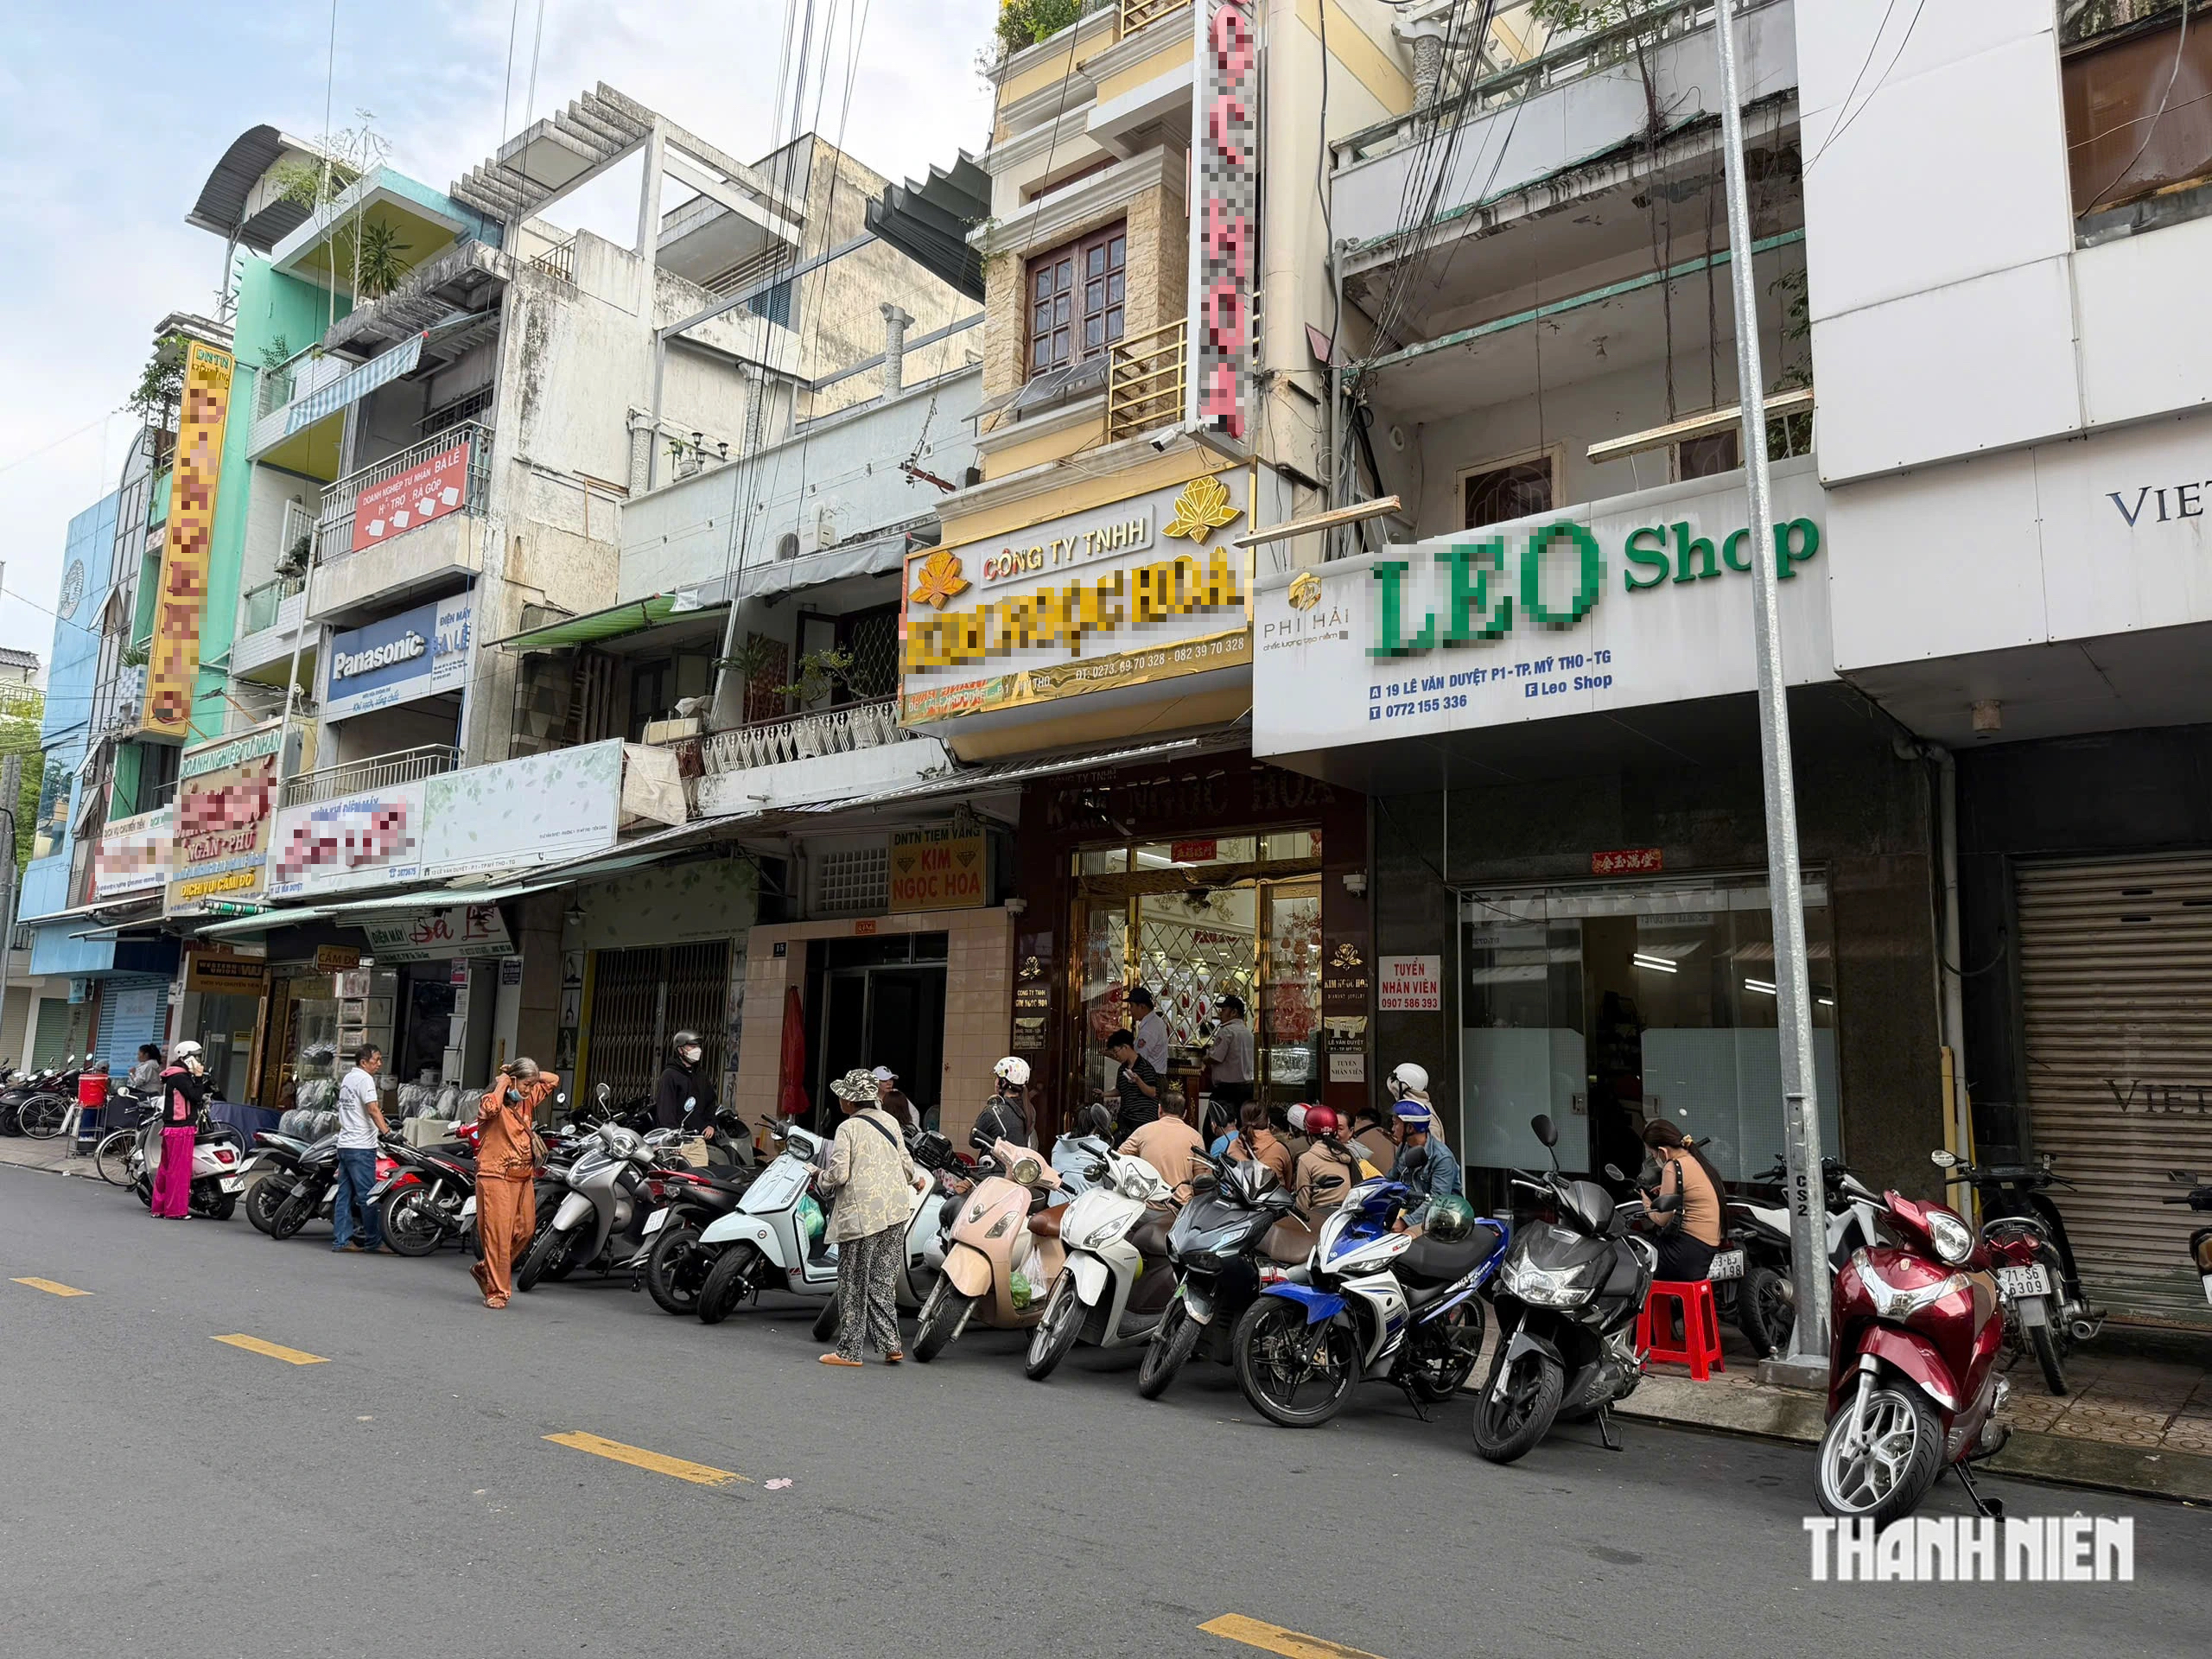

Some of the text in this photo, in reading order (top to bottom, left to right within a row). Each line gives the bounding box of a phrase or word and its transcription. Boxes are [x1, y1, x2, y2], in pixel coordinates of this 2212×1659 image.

[363, 490, 383, 505] DOANH
[414, 467, 431, 484] NHÂN
[2105, 480, 2212, 528] VIE
[983, 518, 1147, 582] CÔNG TY TNHH
[440, 612, 454, 627] ĐIỆN
[1264, 606, 1349, 639] PHI HẢI
[333, 630, 426, 680] Panasonic
[1134, 658, 1145, 670] 70
[1147, 652, 1165, 666] 328
[1174, 646, 1192, 663] 082
[1195, 645, 1207, 658] 39
[1211, 642, 1223, 655] 70
[1225, 638, 1244, 652] 328
[1033, 675, 1051, 688] THO
[1386, 683, 1399, 697] 19
[1403, 678, 1417, 694] LÊ
[1421, 675, 1444, 691] VĂN
[1450, 668, 1487, 687] DUYỆT
[1535, 656, 1554, 674] MỸ
[1559, 653, 1584, 671] THO
[1542, 681, 1567, 696] Leo
[1573, 674, 1612, 690] Shop
[1386, 702, 1414, 718] 0772
[1418, 698, 1440, 713] 155
[1443, 694, 1467, 709] 336
[180, 753, 209, 779] DOANH
[894, 831, 921, 845] DNTN
[921, 848, 951, 871] KIM
[181, 882, 202, 901] DỊCH
[893, 871, 981, 905] NGỌC HOA
[318, 950, 341, 964] CẦM
[346, 950, 360, 965] ĐỒ
[776, 944, 785, 952] 15
[199, 961, 237, 969] WESTERN
[1394, 957, 1425, 976] TUYỂN
[1382, 978, 1437, 994] NHÂN VIÊN
[1382, 998, 1438, 1008] 0907 586 393
[2005, 1268, 2039, 1281] 71-S6
